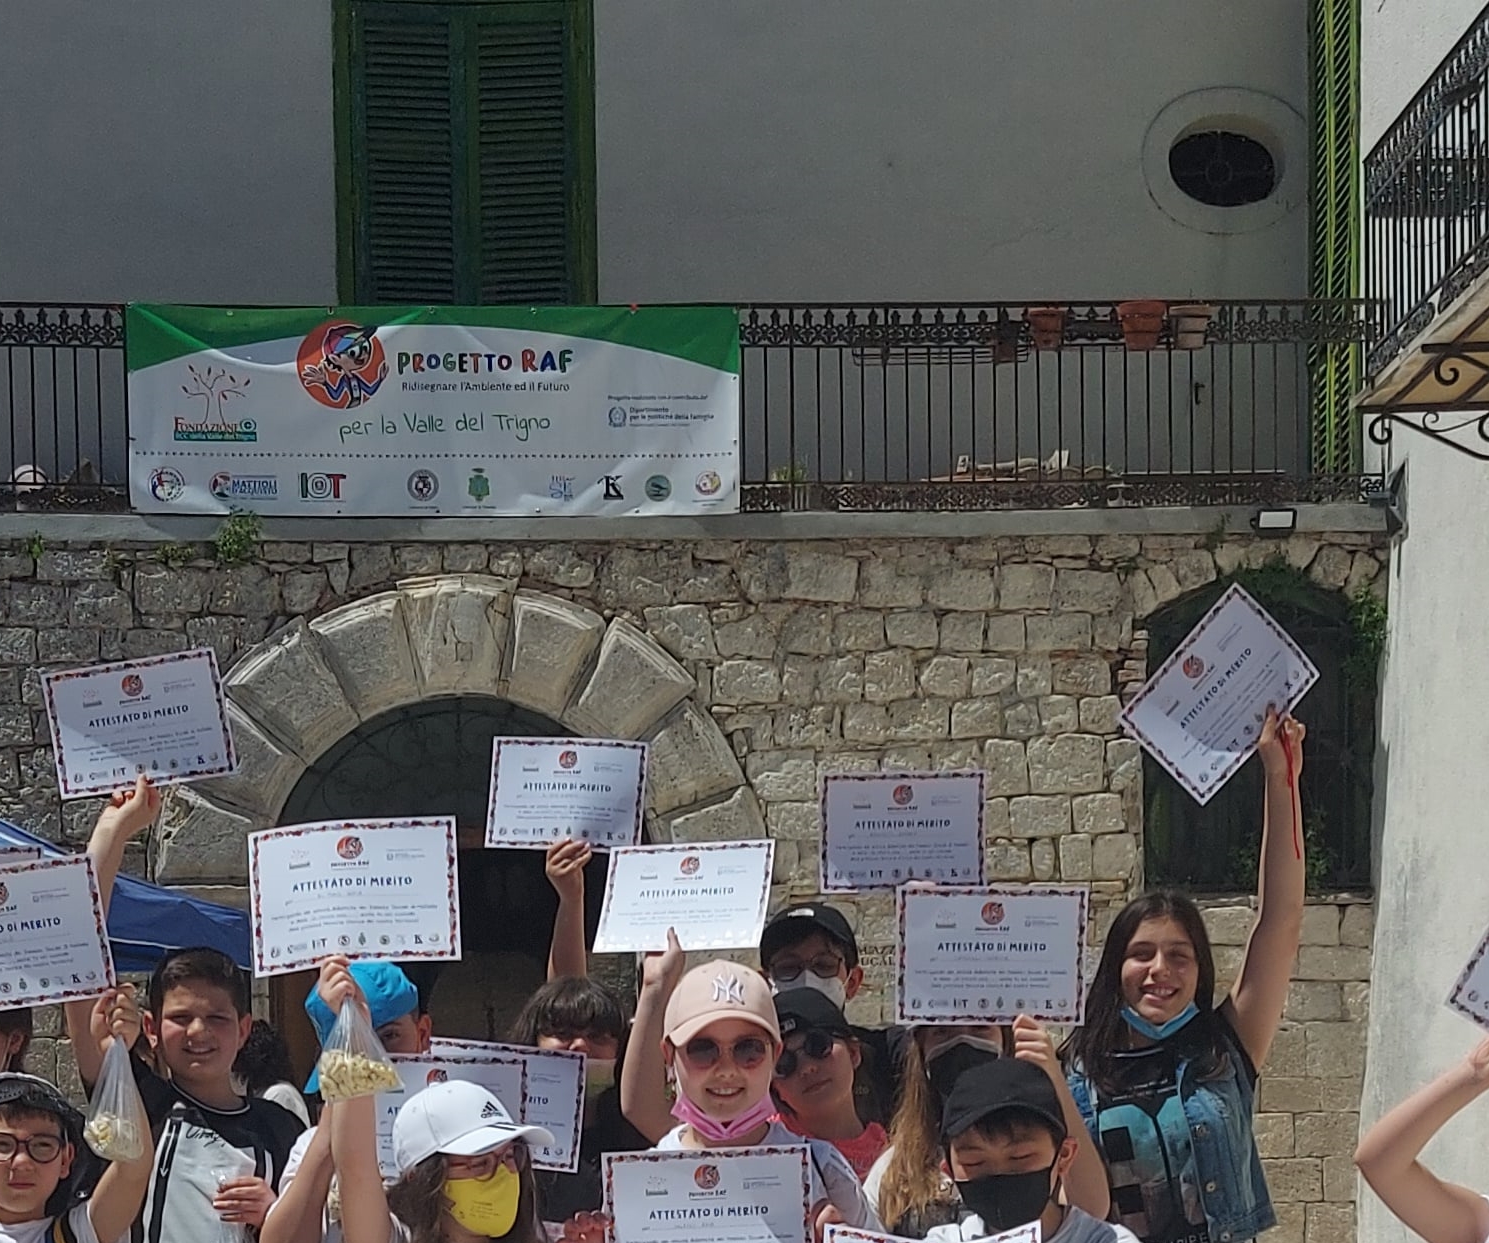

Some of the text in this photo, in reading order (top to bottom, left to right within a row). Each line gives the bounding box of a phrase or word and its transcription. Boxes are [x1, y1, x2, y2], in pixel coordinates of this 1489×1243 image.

[397, 348, 573, 375] PROGETTO RAF
[402, 381, 570, 392] Ridisegnare l'Ambiente ed il Futuro
[339, 412, 551, 444] per la Valle del Trigno
[1180, 686, 1219, 729] ATTESTATO
[89, 712, 141, 728] ATTESTATO
[523, 782, 568, 792] ATTESTATO
[854, 818, 905, 830] ATTESTATO
[292, 877, 352, 892] ATTESTATO
[640, 889, 688, 899] ATTESTATO
[937, 941, 994, 952] ATTESTATO
[649, 1206, 711, 1220] ATTESTATO
